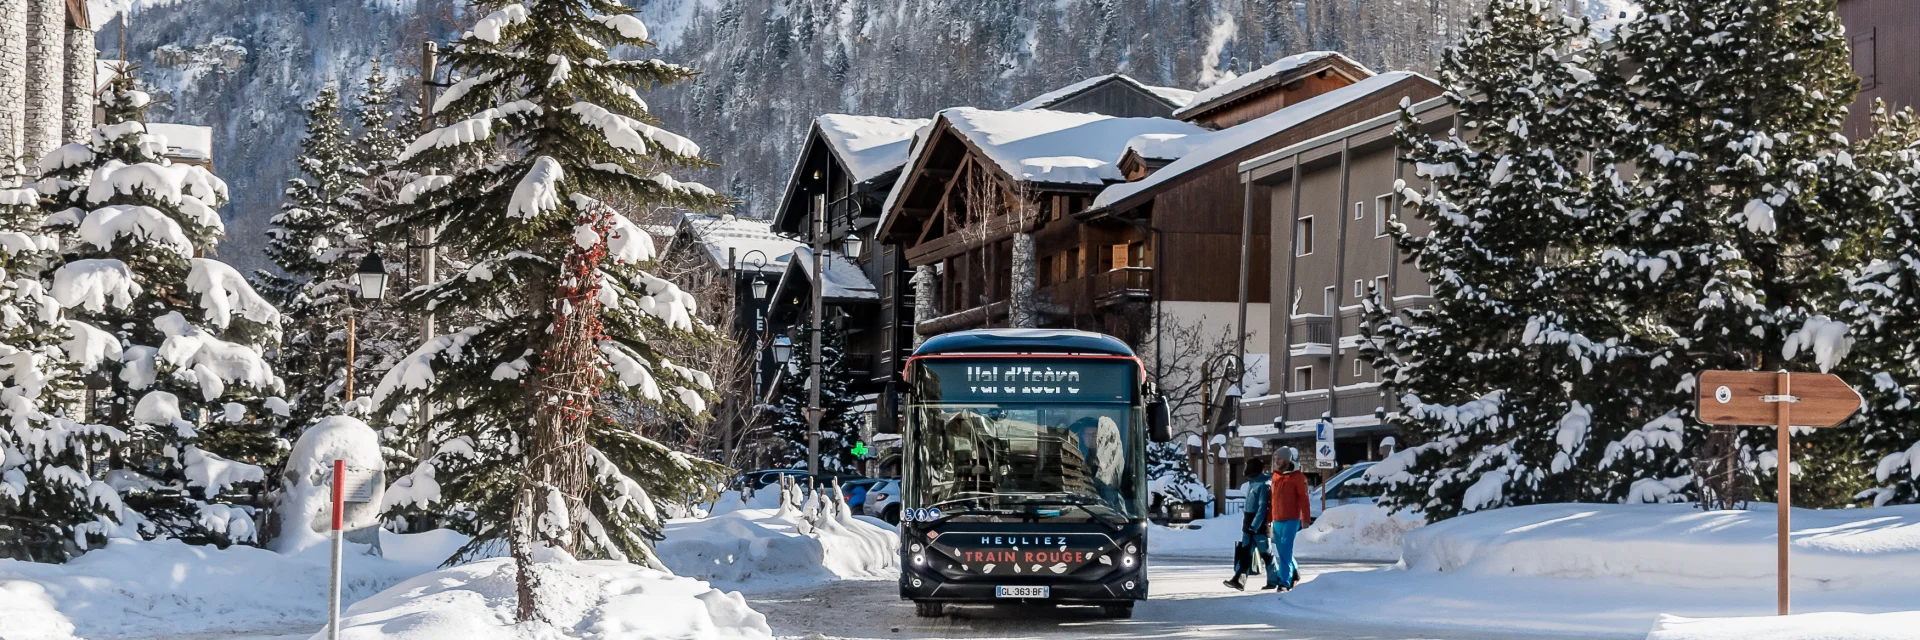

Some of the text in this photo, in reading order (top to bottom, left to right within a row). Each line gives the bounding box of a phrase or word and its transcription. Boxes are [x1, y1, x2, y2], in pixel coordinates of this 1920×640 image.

[756, 308, 764, 331] LE
[967, 366, 998, 394] Val
[981, 536, 1067, 545] HEULIEZ
[965, 551, 1083, 563] TRAIN ROUGE
[1001, 587, 1044, 596] GL-363-BF
